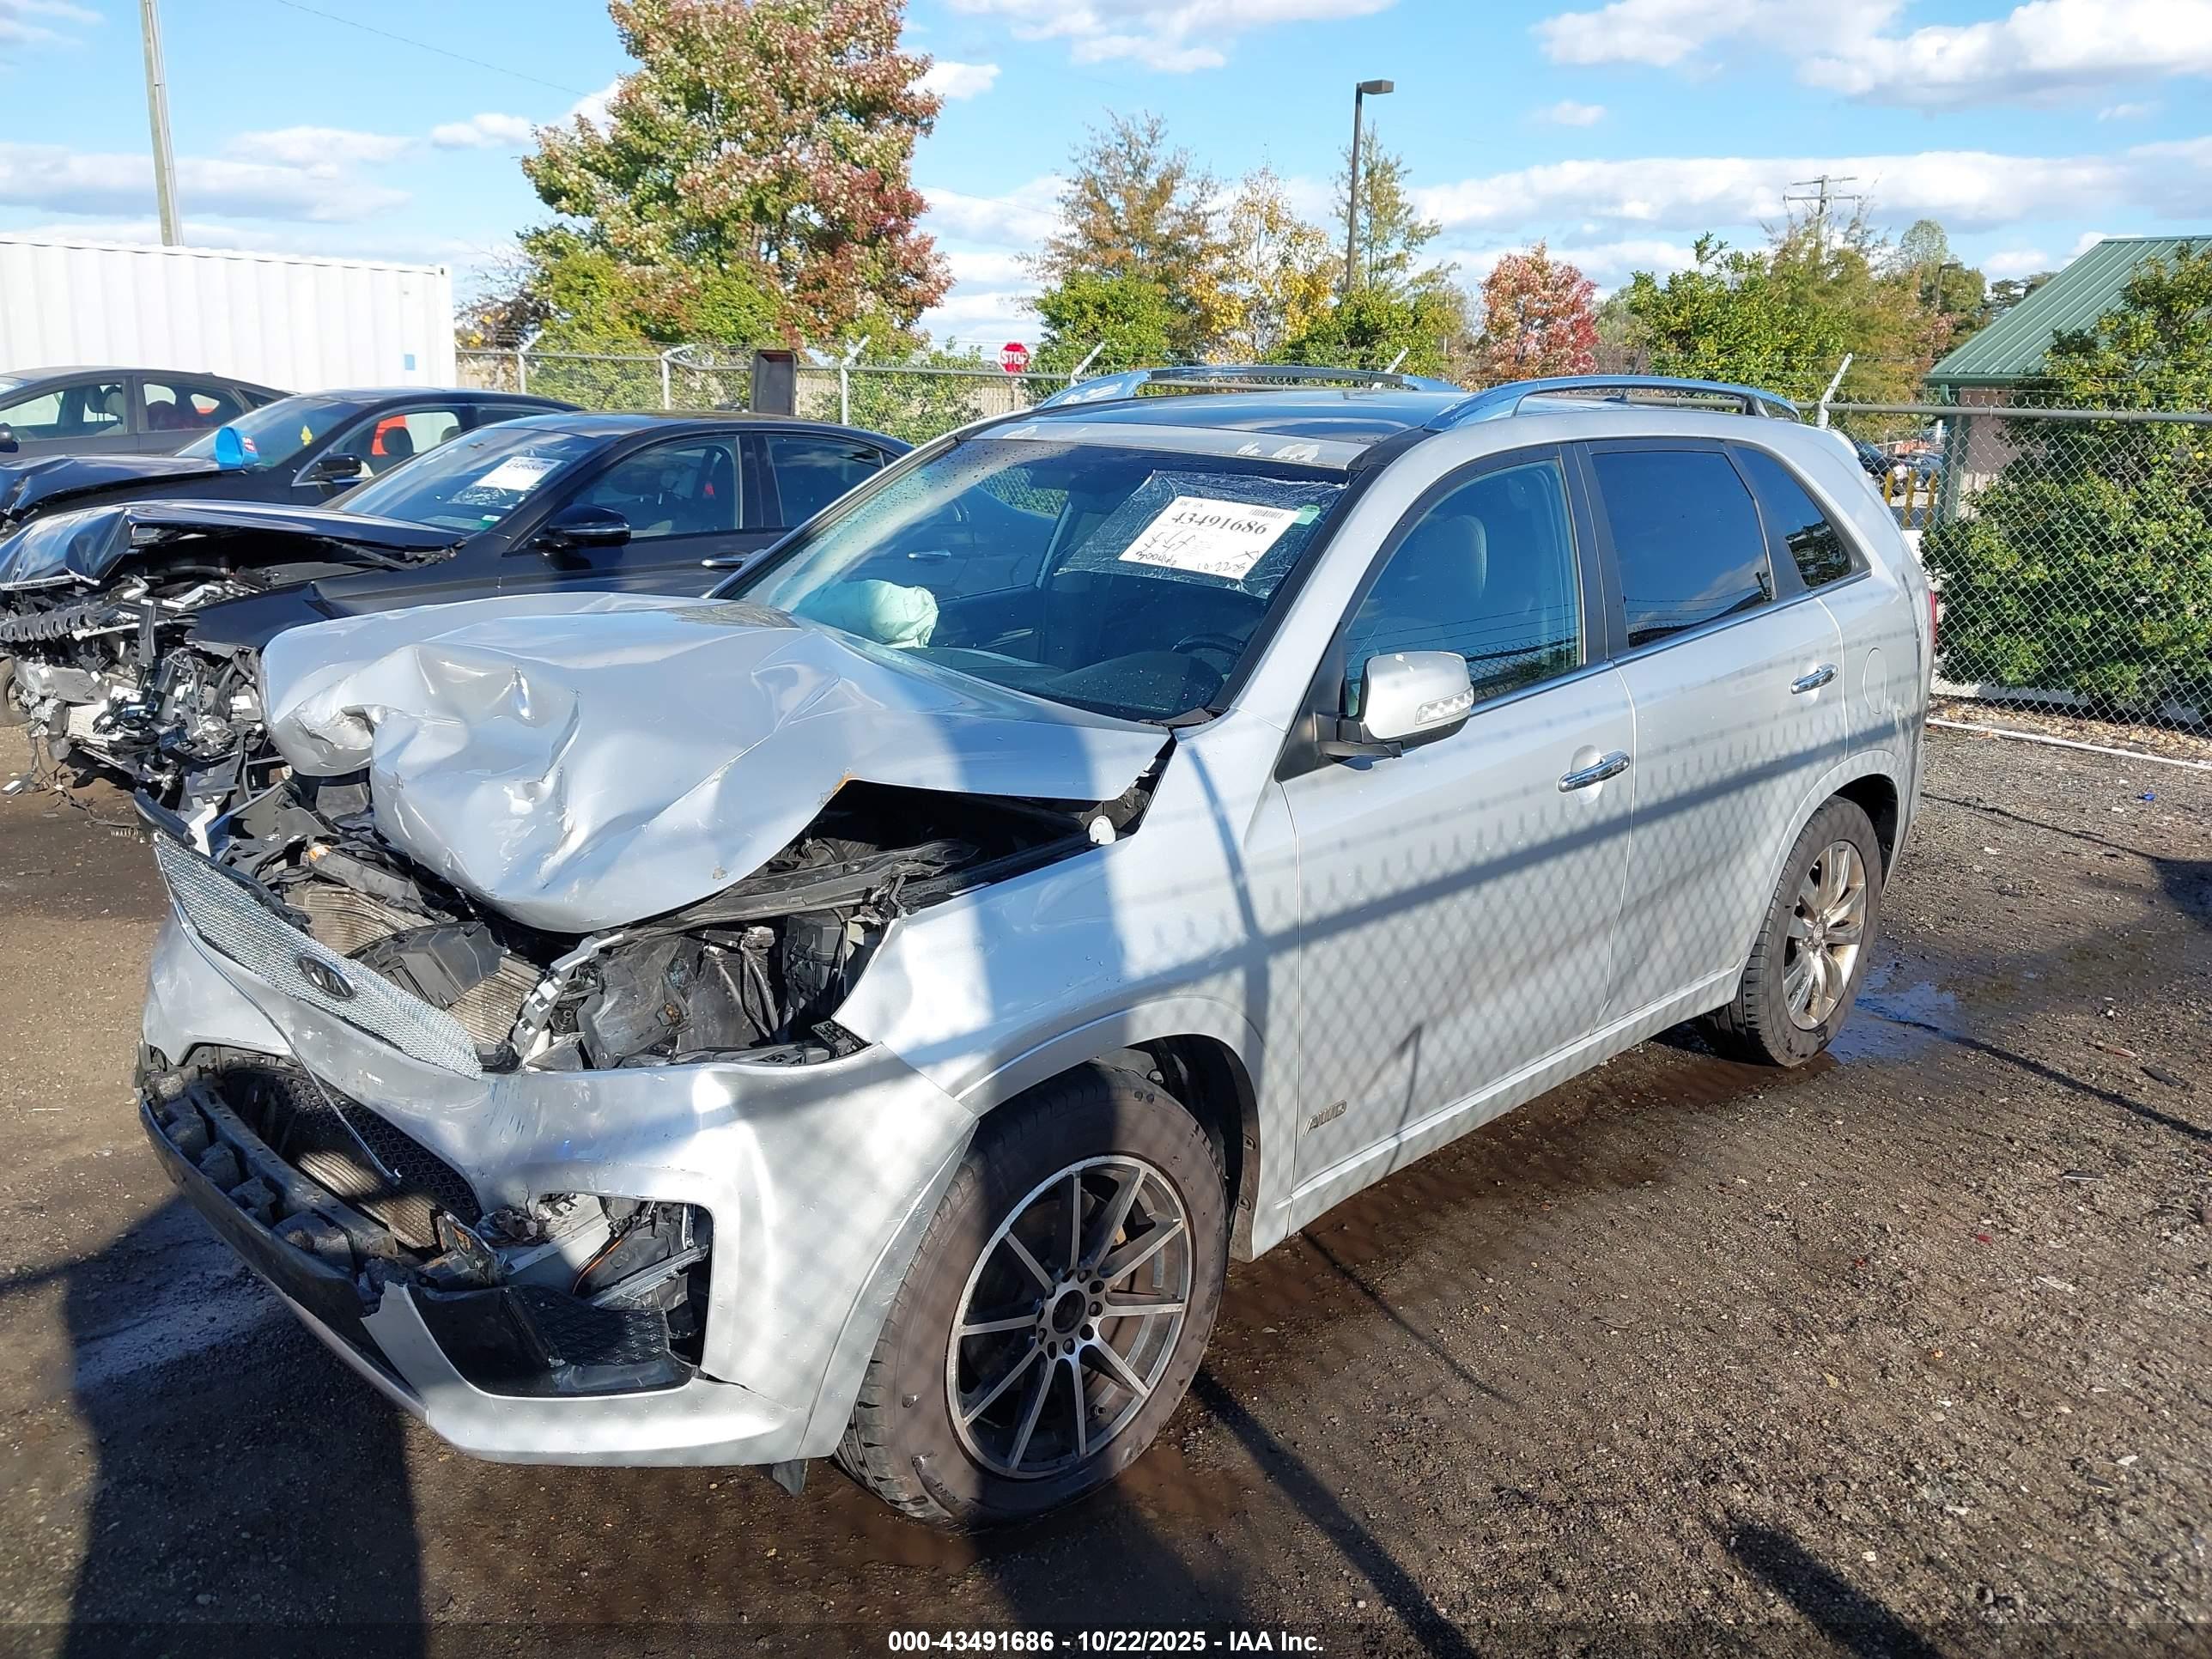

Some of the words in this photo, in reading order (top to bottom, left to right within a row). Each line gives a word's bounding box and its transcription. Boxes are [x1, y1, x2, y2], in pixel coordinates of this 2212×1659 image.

[1000, 349, 1029, 365] STOP
[1171, 511, 1271, 536] 43491686
[1303, 1100, 1347, 1138] AWD
